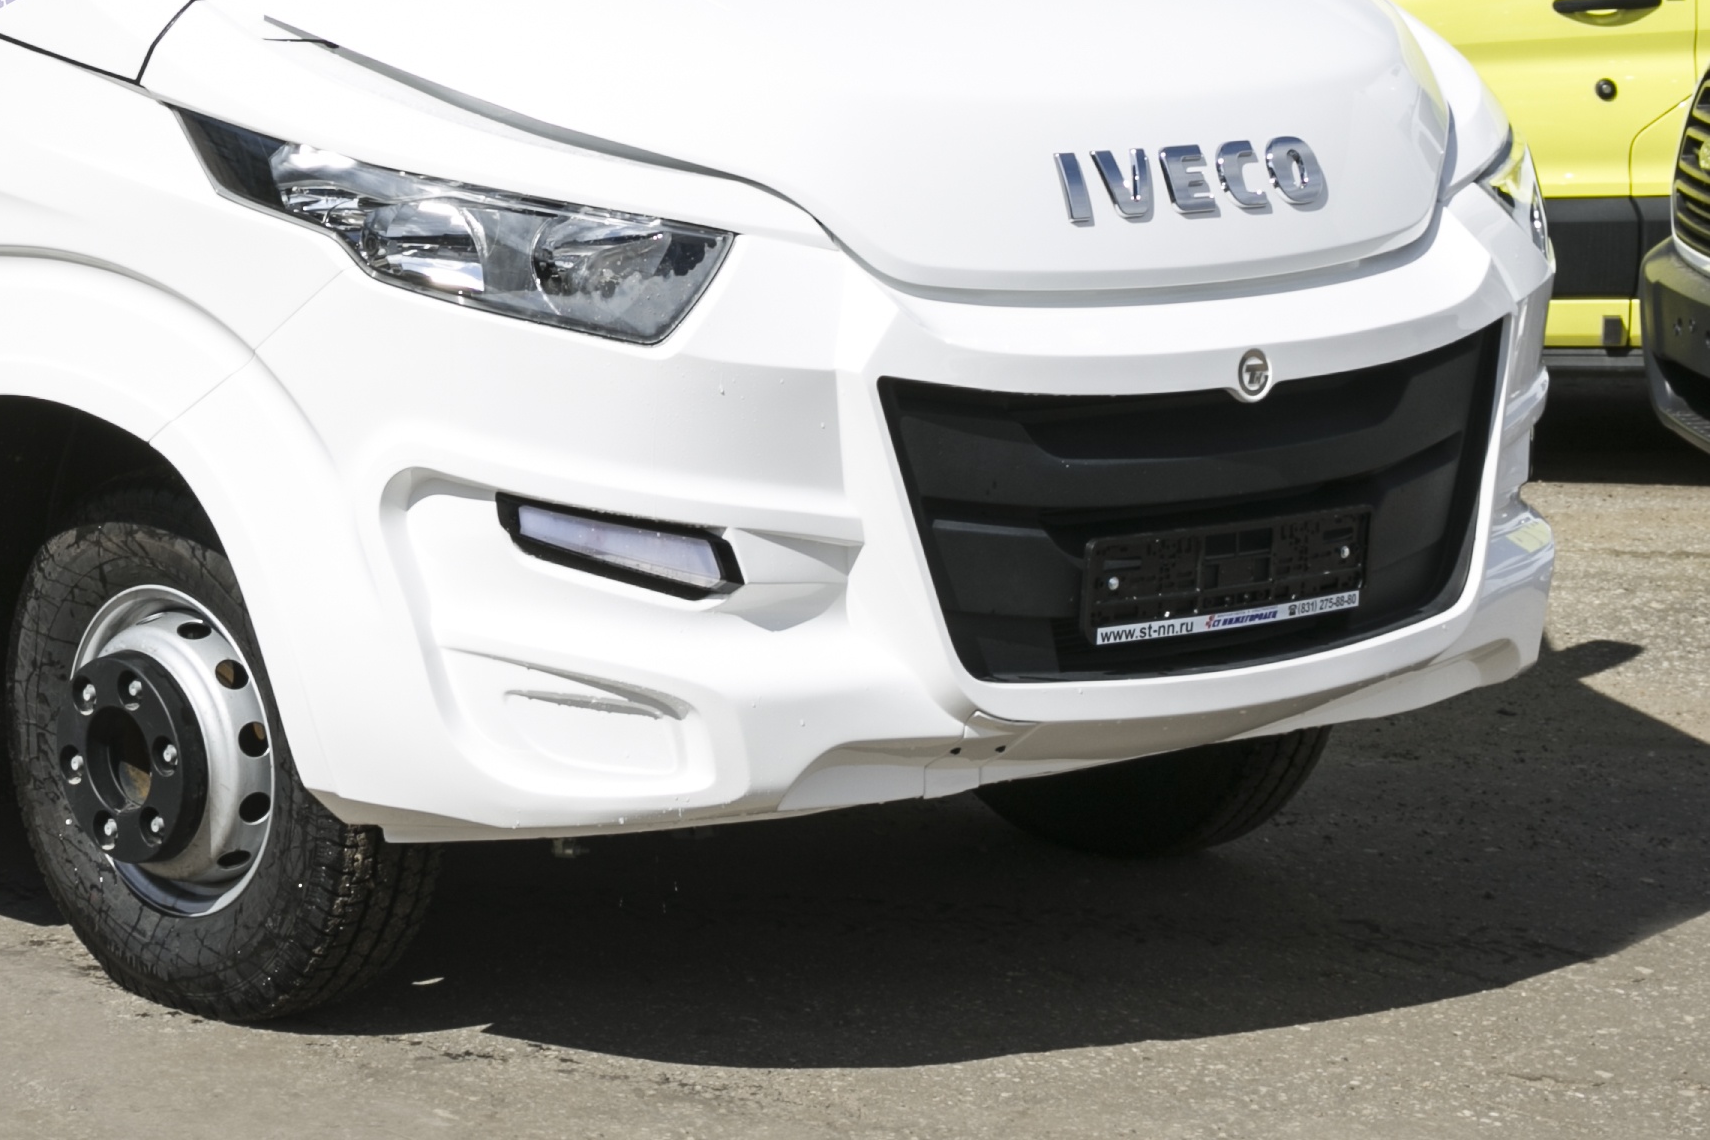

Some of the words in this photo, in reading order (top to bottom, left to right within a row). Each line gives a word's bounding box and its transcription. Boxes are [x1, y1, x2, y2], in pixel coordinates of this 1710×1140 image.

[1053, 136, 1324, 224] IVECO
[1298, 600, 1317, 615] (831)
[1100, 621, 1194, 643] www.st-nn.ru
